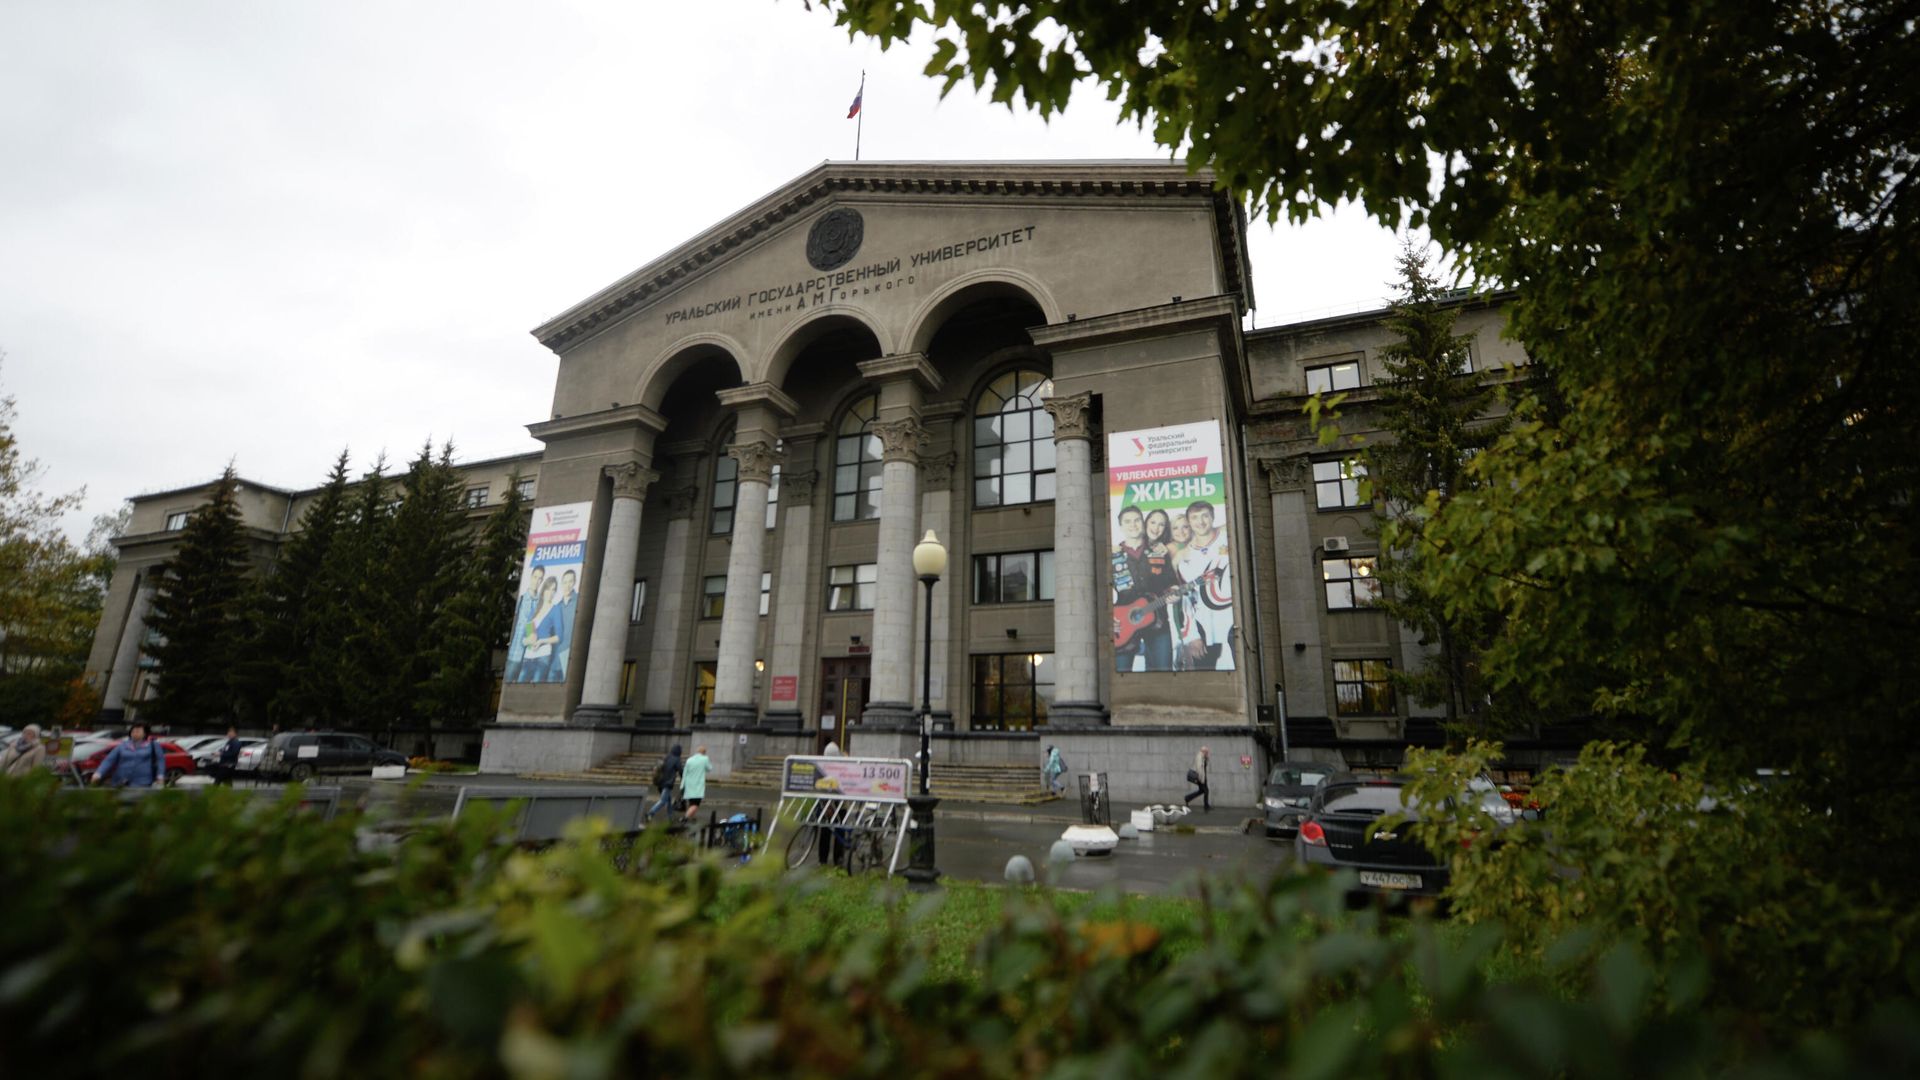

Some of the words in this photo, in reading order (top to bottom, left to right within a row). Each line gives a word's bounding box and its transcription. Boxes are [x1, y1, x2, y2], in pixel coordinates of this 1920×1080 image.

[665, 295, 741, 325] УРАЛЬСКИЙ
[747, 256, 901, 306] ГОСУДАРСТВЕННЫЙ
[910, 225, 1036, 268] УНИВЕРСИТЕТ
[1116, 464, 1198, 482] УВЛЕКАТЕЛЬНАЯ
[1130, 477, 1216, 503] ЖИЗНЬ
[536, 543, 582, 561] ЗНАНИЯ
[863, 767, 876, 779] 13
[879, 767, 901, 780] 500
